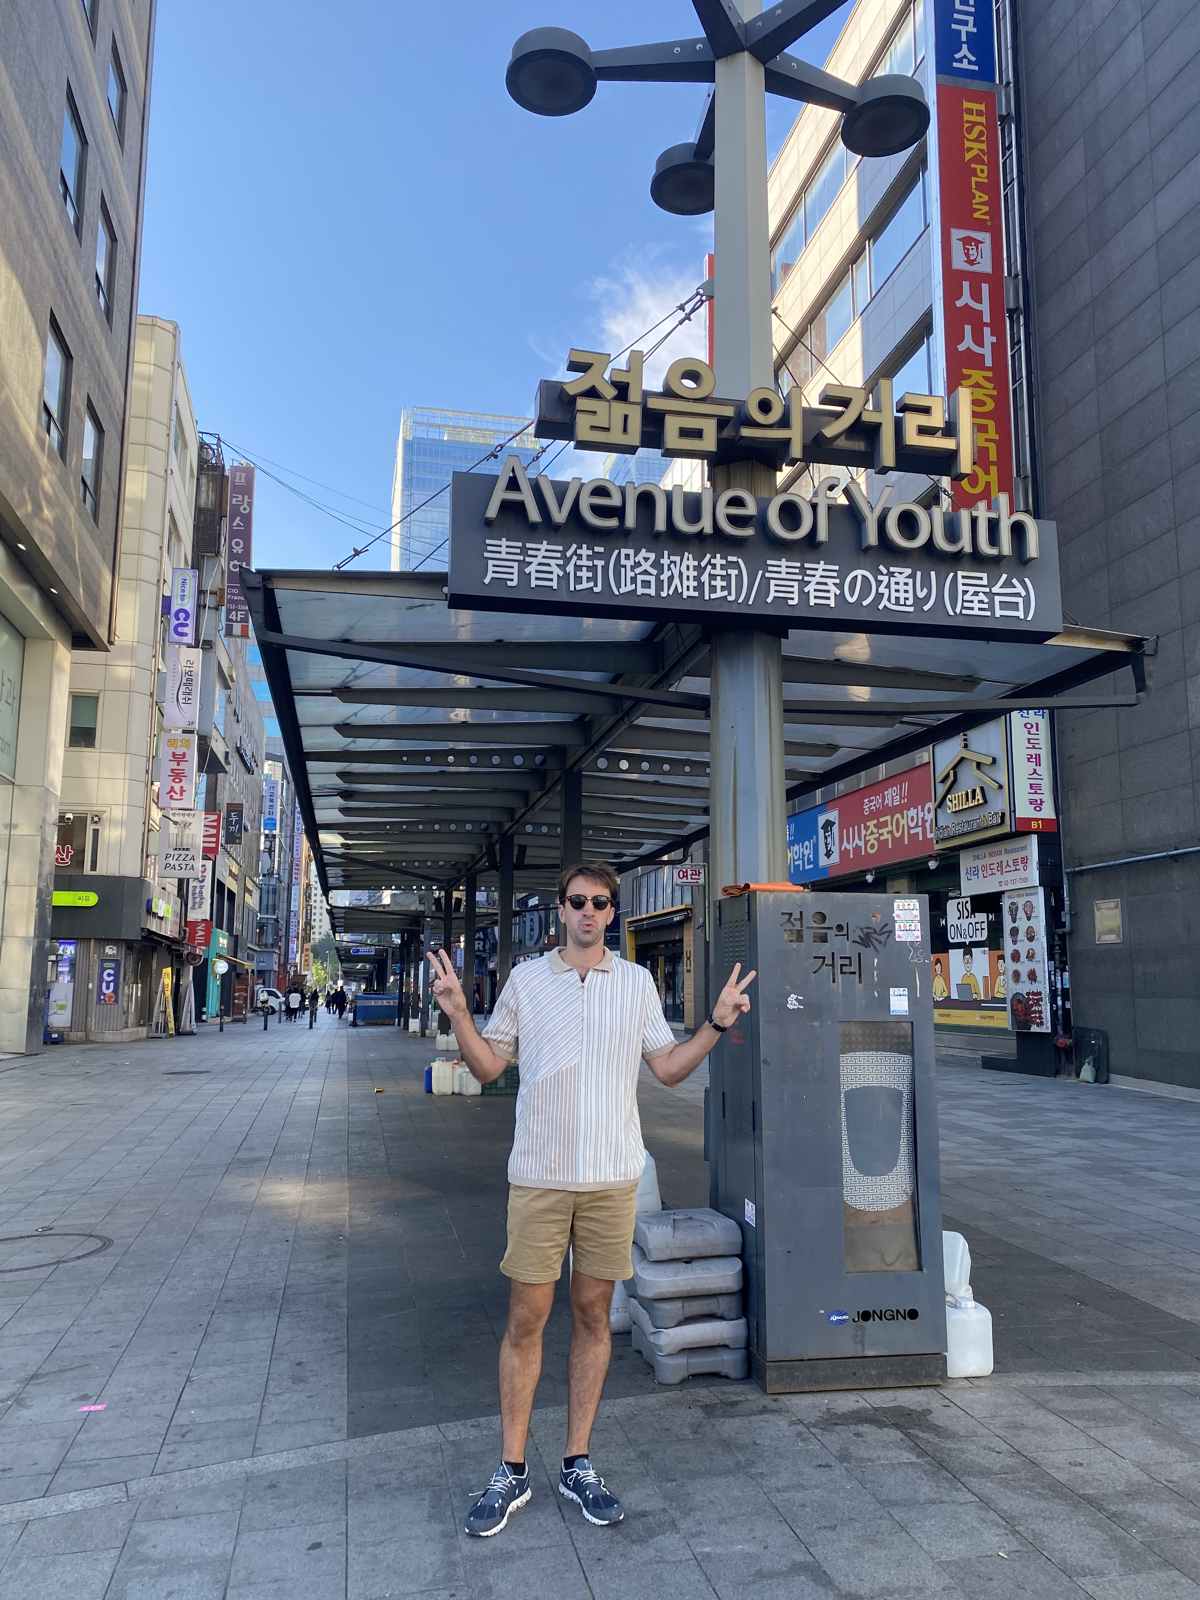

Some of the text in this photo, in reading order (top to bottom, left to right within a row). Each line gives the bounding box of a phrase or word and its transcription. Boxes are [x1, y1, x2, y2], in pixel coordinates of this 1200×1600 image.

[963, 99, 990, 220] HSK PLAN
[484, 454, 1040, 560] Avenue of Youth
[180, 578, 188, 602] Nice to
[173, 608, 190, 637] CU
[228, 611, 246, 621] 4F
[167, 738, 191, 750] 리치
[165, 751, 189, 802] 부동산
[1023, 721, 1046, 813] 인도레스토랑
[862, 792, 883, 815] 중국어
[946, 785, 985, 813] SHILLA
[202, 814, 218, 848] NAIL
[228, 812, 240, 833] 두끼
[841, 801, 935, 859] 시사중국어학원
[934, 825, 951, 840] Indian
[951, 815, 984, 836] Restaurant
[988, 811, 1002, 826] Bar
[1031, 820, 1043, 829] B1
[164, 853, 196, 862] PIZZA
[972, 844, 1028, 861] SHILLA INDIAN Restaurant
[163, 862, 195, 871] PASTA
[677, 869, 703, 880] 여관
[964, 855, 1029, 881] 신라 인도레스토랑
[195, 922, 206, 948] NAIL
[780, 910, 849, 943] 젊음의
[949, 920, 986, 940] ON&OFF
[101, 968, 115, 994] CU
[812, 952, 863, 984] 거리
[852, 1308, 919, 1323] JONGNO
